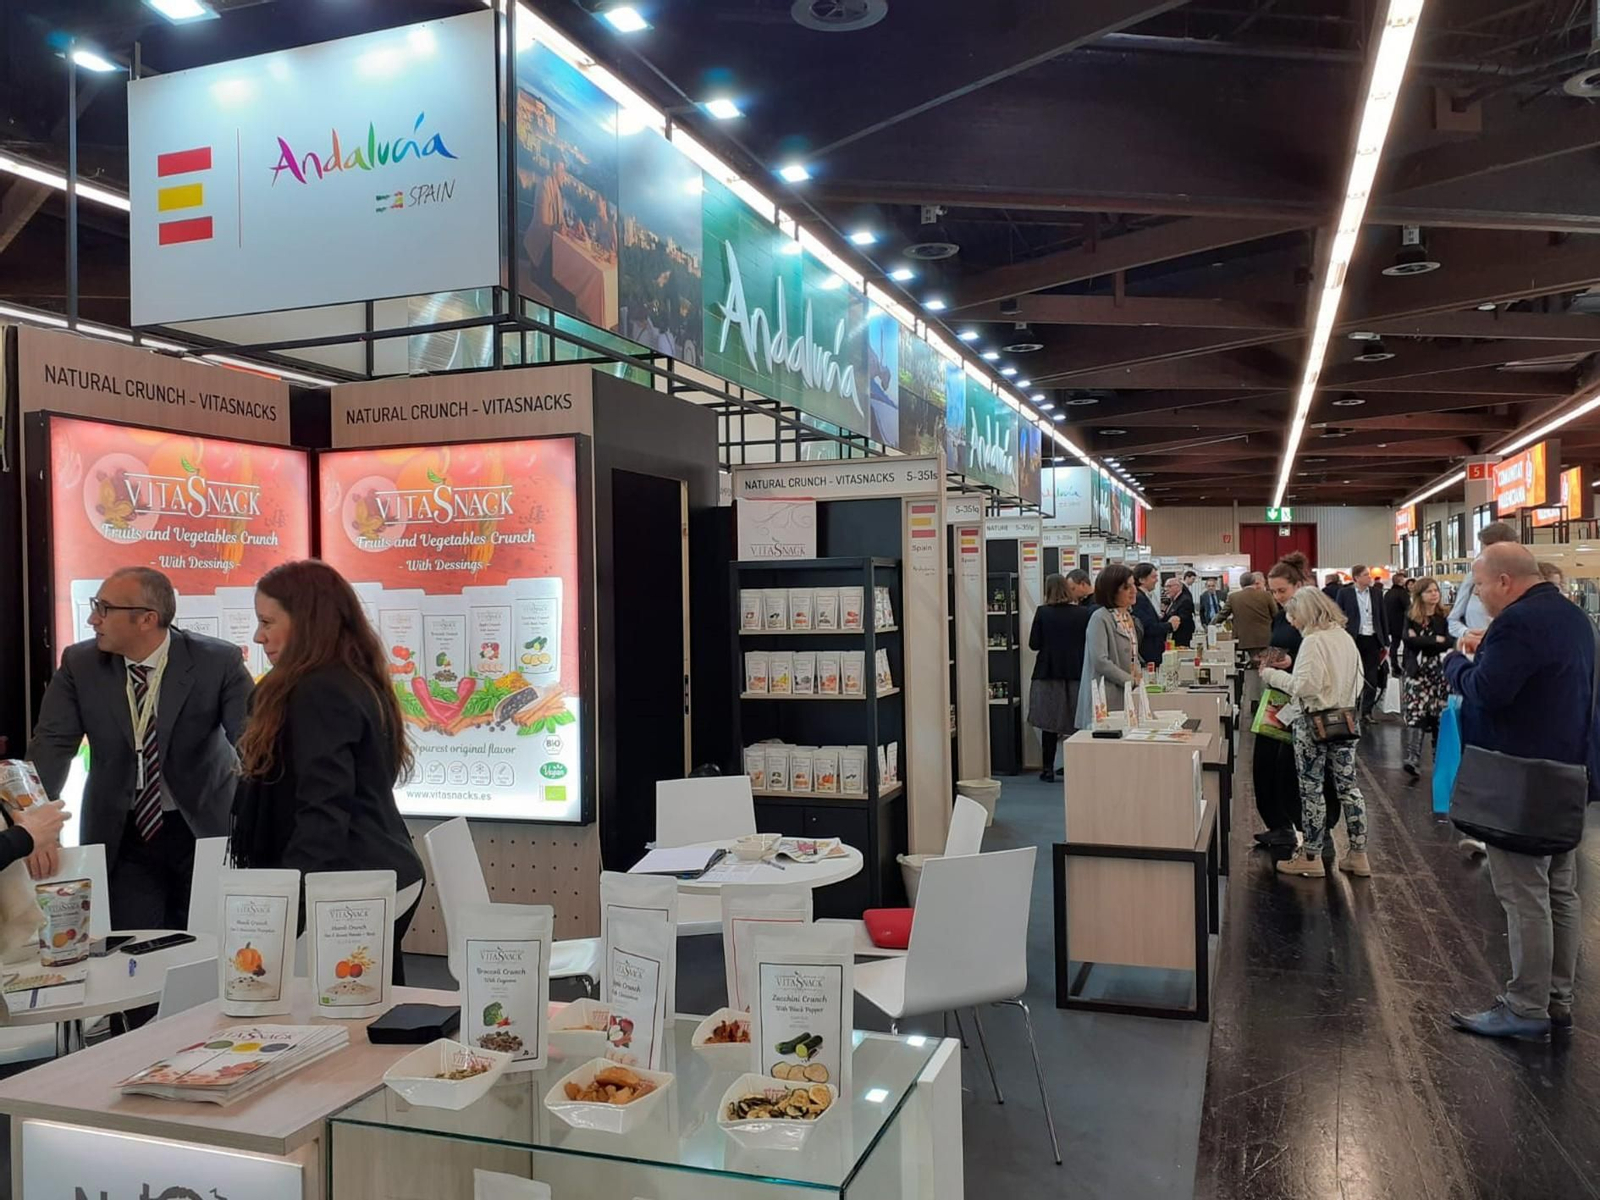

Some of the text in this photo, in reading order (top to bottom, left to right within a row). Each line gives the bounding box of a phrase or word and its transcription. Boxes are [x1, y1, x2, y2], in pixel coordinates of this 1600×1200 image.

[269, 111, 459, 188] Andalucía
[408, 179, 456, 207] SPAIN
[717, 239, 865, 419] Andalucía
[44, 363, 121, 396] NATURAL
[125, 379, 186, 406] CRUNCH
[199, 393, 277, 422] VITASNACKS
[346, 407, 408, 425] NATURAL
[411, 401, 468, 420] CRUNCH
[482, 393, 573, 416] VITASNACKS
[1474, 467, 1480, 476] 5
[744, 478, 787, 490] NATURAL
[788, 475, 828, 488] CRUNCH
[835, 472, 896, 486] VITASNACKS
[101, 523, 279, 548] Fruits and Vegetables Crunch
[356, 529, 536, 551] Fruits and Vegetables Crunch
[911, 544, 933, 553] Spain
[158, 556, 187, 569] With
[188, 558, 236, 574] Dessings
[406, 559, 432, 572] With
[435, 558, 484, 575] Dessings
[419, 744, 449, 756] purest
[450, 743, 487, 757] original
[487, 743, 517, 757] flavor
[406, 789, 492, 801] www.vitasnacks.es
[502, 967, 526, 975] Crunch
[772, 994, 828, 1004] Zucchini Crunch
